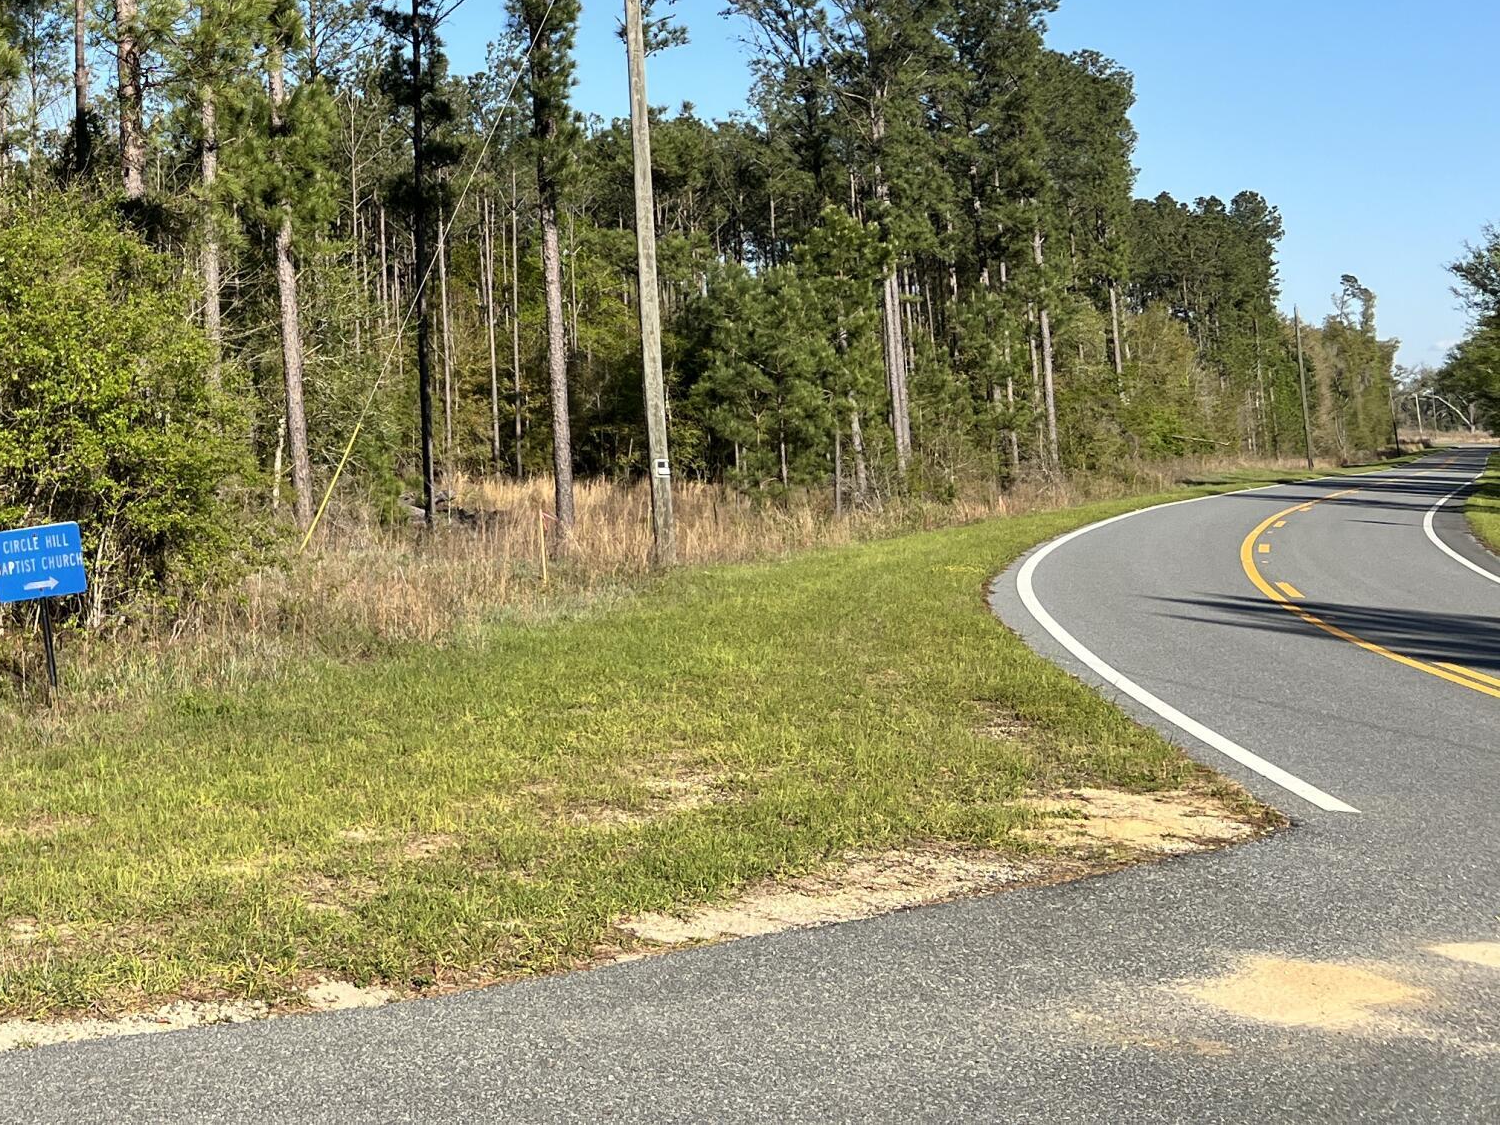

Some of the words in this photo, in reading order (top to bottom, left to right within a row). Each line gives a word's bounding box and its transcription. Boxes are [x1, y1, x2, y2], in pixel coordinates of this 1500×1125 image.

[3, 536, 39, 554] CIRCLE
[45, 533, 69, 549] HILL
[42, 552, 83, 570] CHURCH
